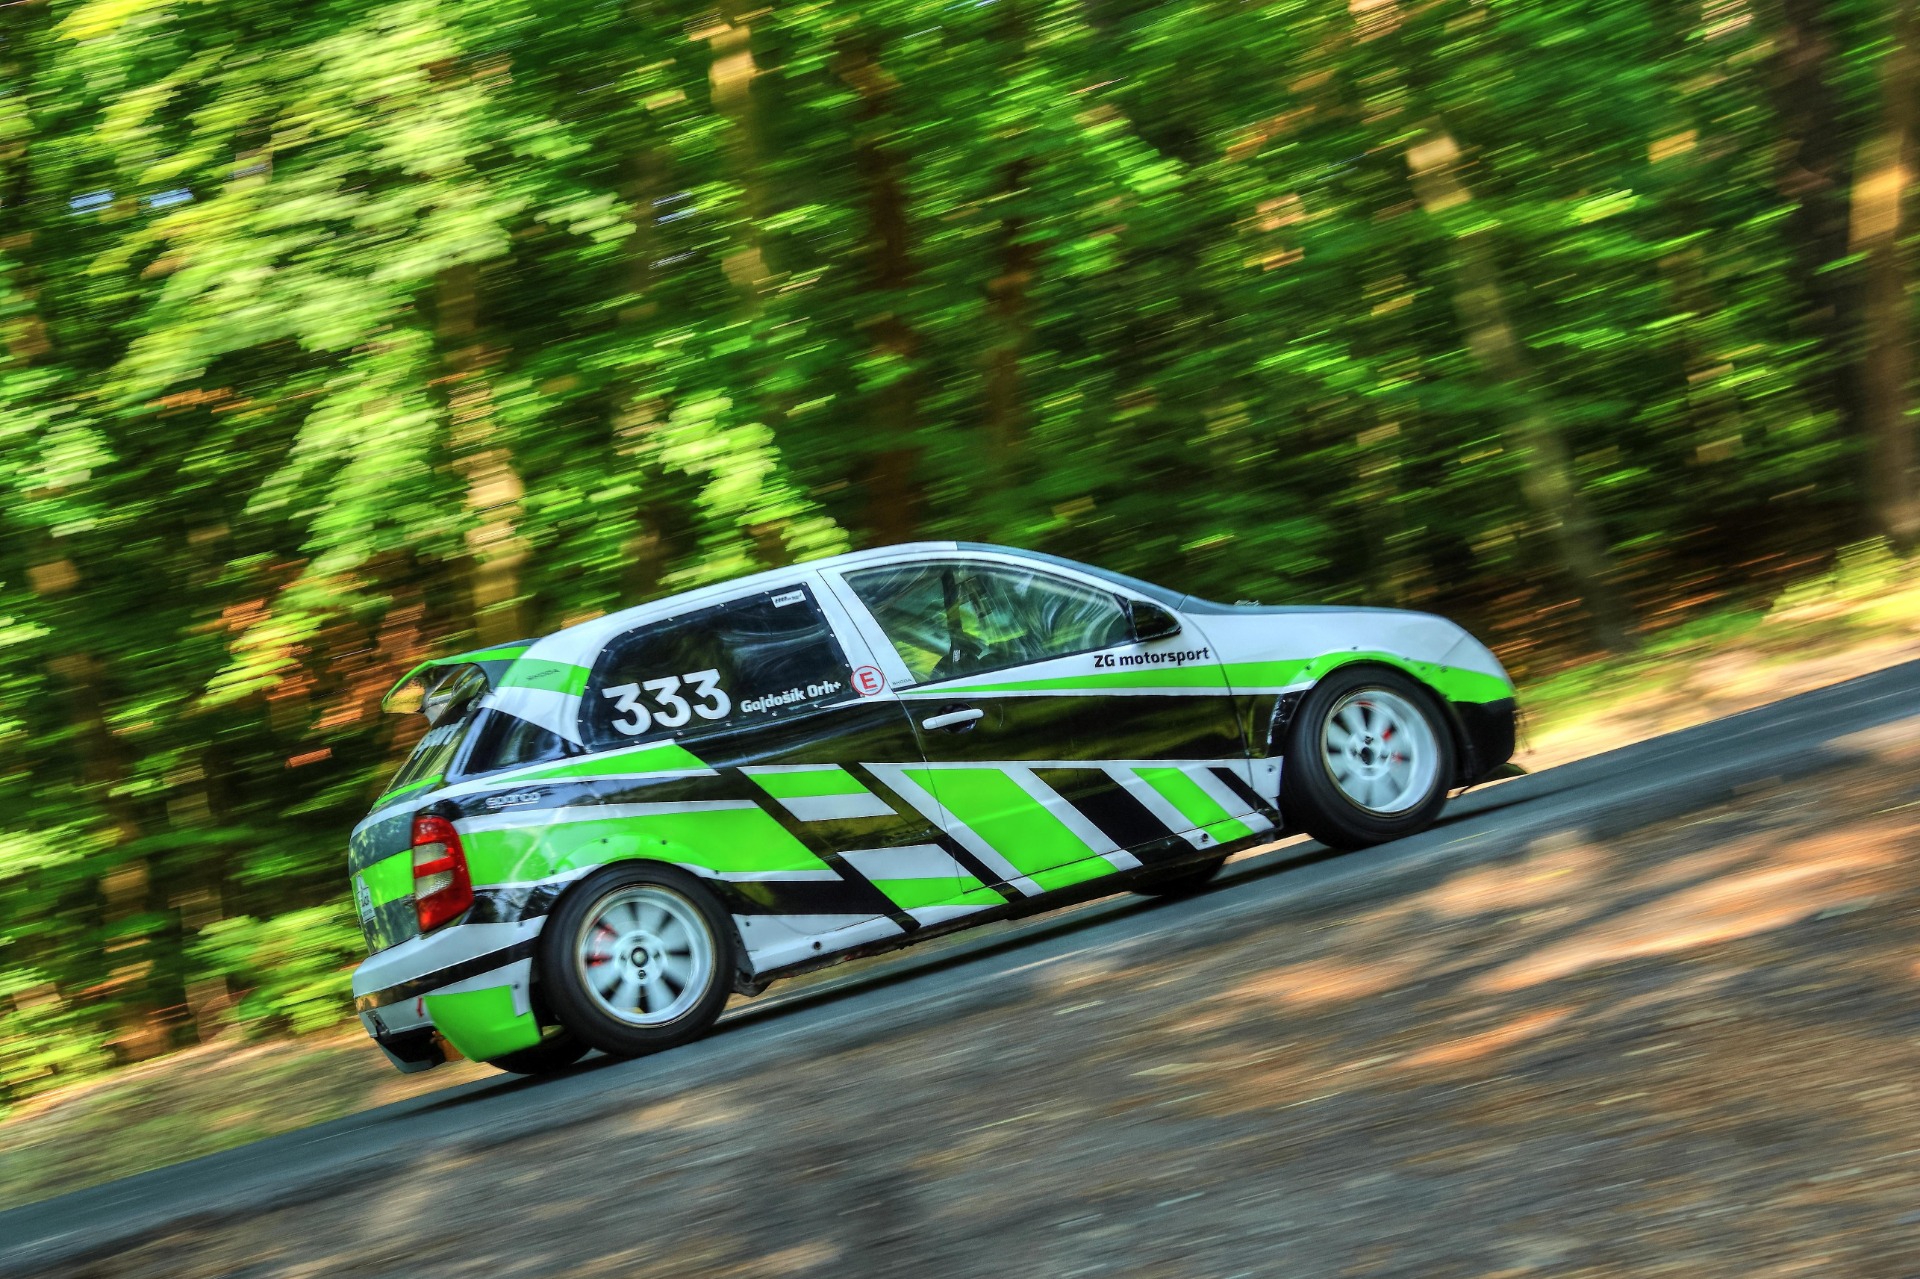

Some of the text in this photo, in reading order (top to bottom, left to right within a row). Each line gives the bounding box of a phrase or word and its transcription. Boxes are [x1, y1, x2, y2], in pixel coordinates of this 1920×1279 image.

[1094, 647, 1210, 668] ZG motorsport
[859, 671, 878, 690] E
[602, 668, 732, 736] 333
